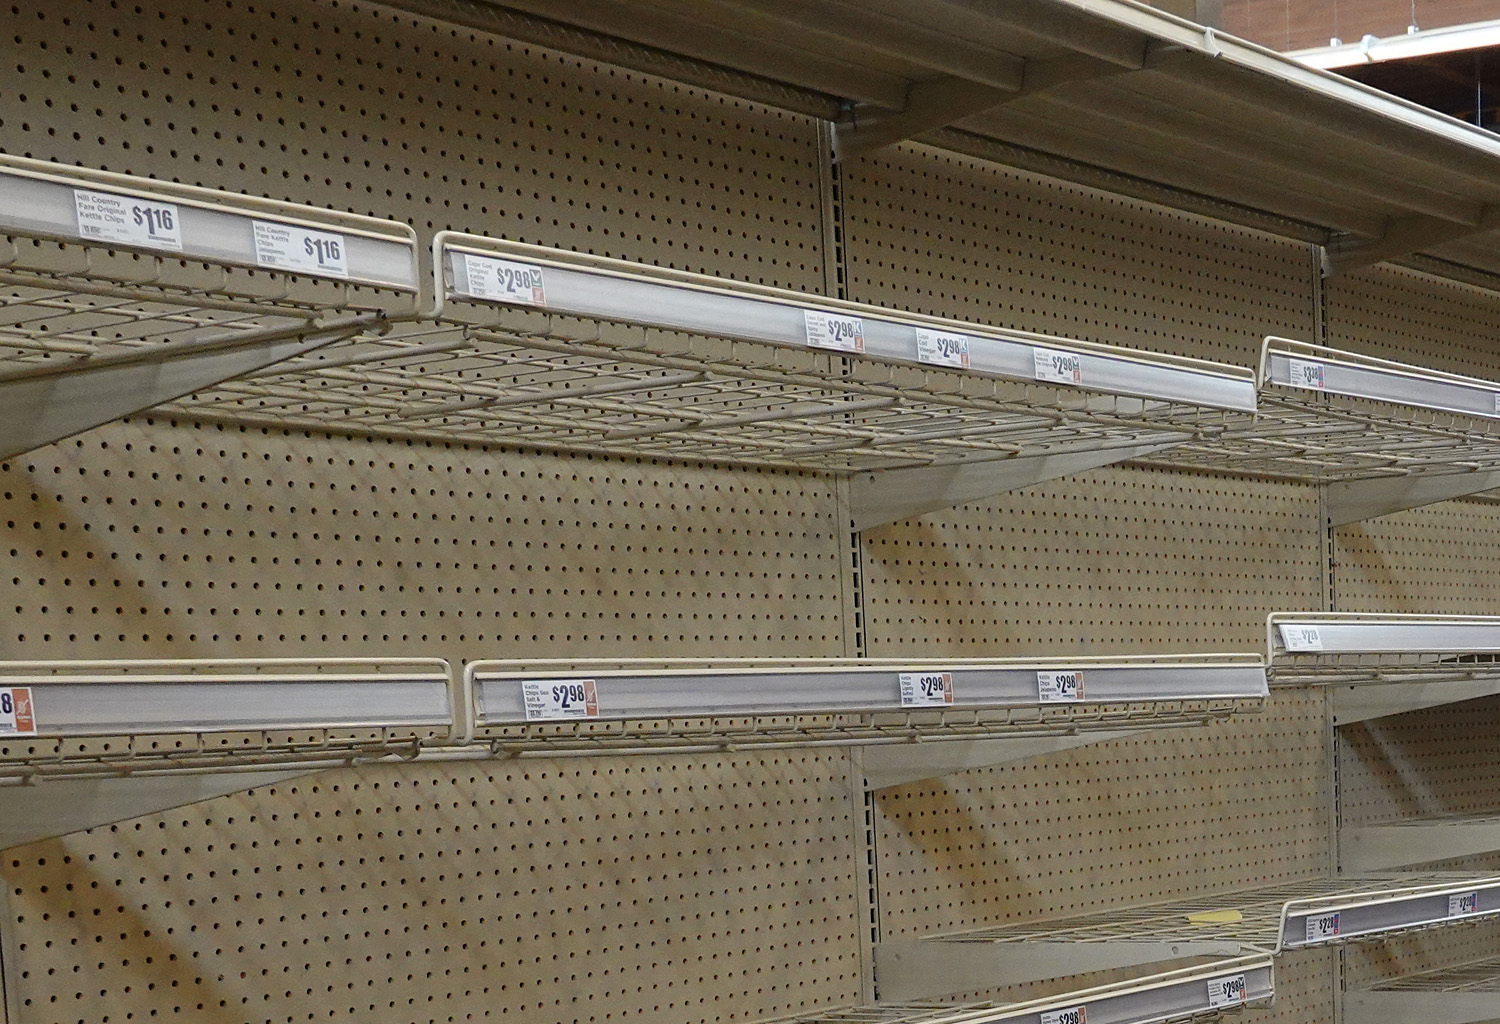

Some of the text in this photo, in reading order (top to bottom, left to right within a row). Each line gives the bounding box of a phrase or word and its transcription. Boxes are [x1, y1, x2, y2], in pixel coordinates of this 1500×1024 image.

[79, 202, 127, 216] Fare Original
[92, 196, 121, 207] Country
[80, 211, 125, 224] Kettle Chips
[132, 205, 174, 235] $116
[267, 226, 290, 236] Country
[304, 236, 340, 264] $116
[497, 267, 531, 293] $298
[828, 320, 853, 342] $298
[937, 338, 960, 358] $298
[1053, 356, 1073, 375] $298
[921, 677, 944, 696] $298
[1055, 675, 1076, 694] $298
[552, 685, 585, 709] $298
[1222, 980, 1239, 998] $298
